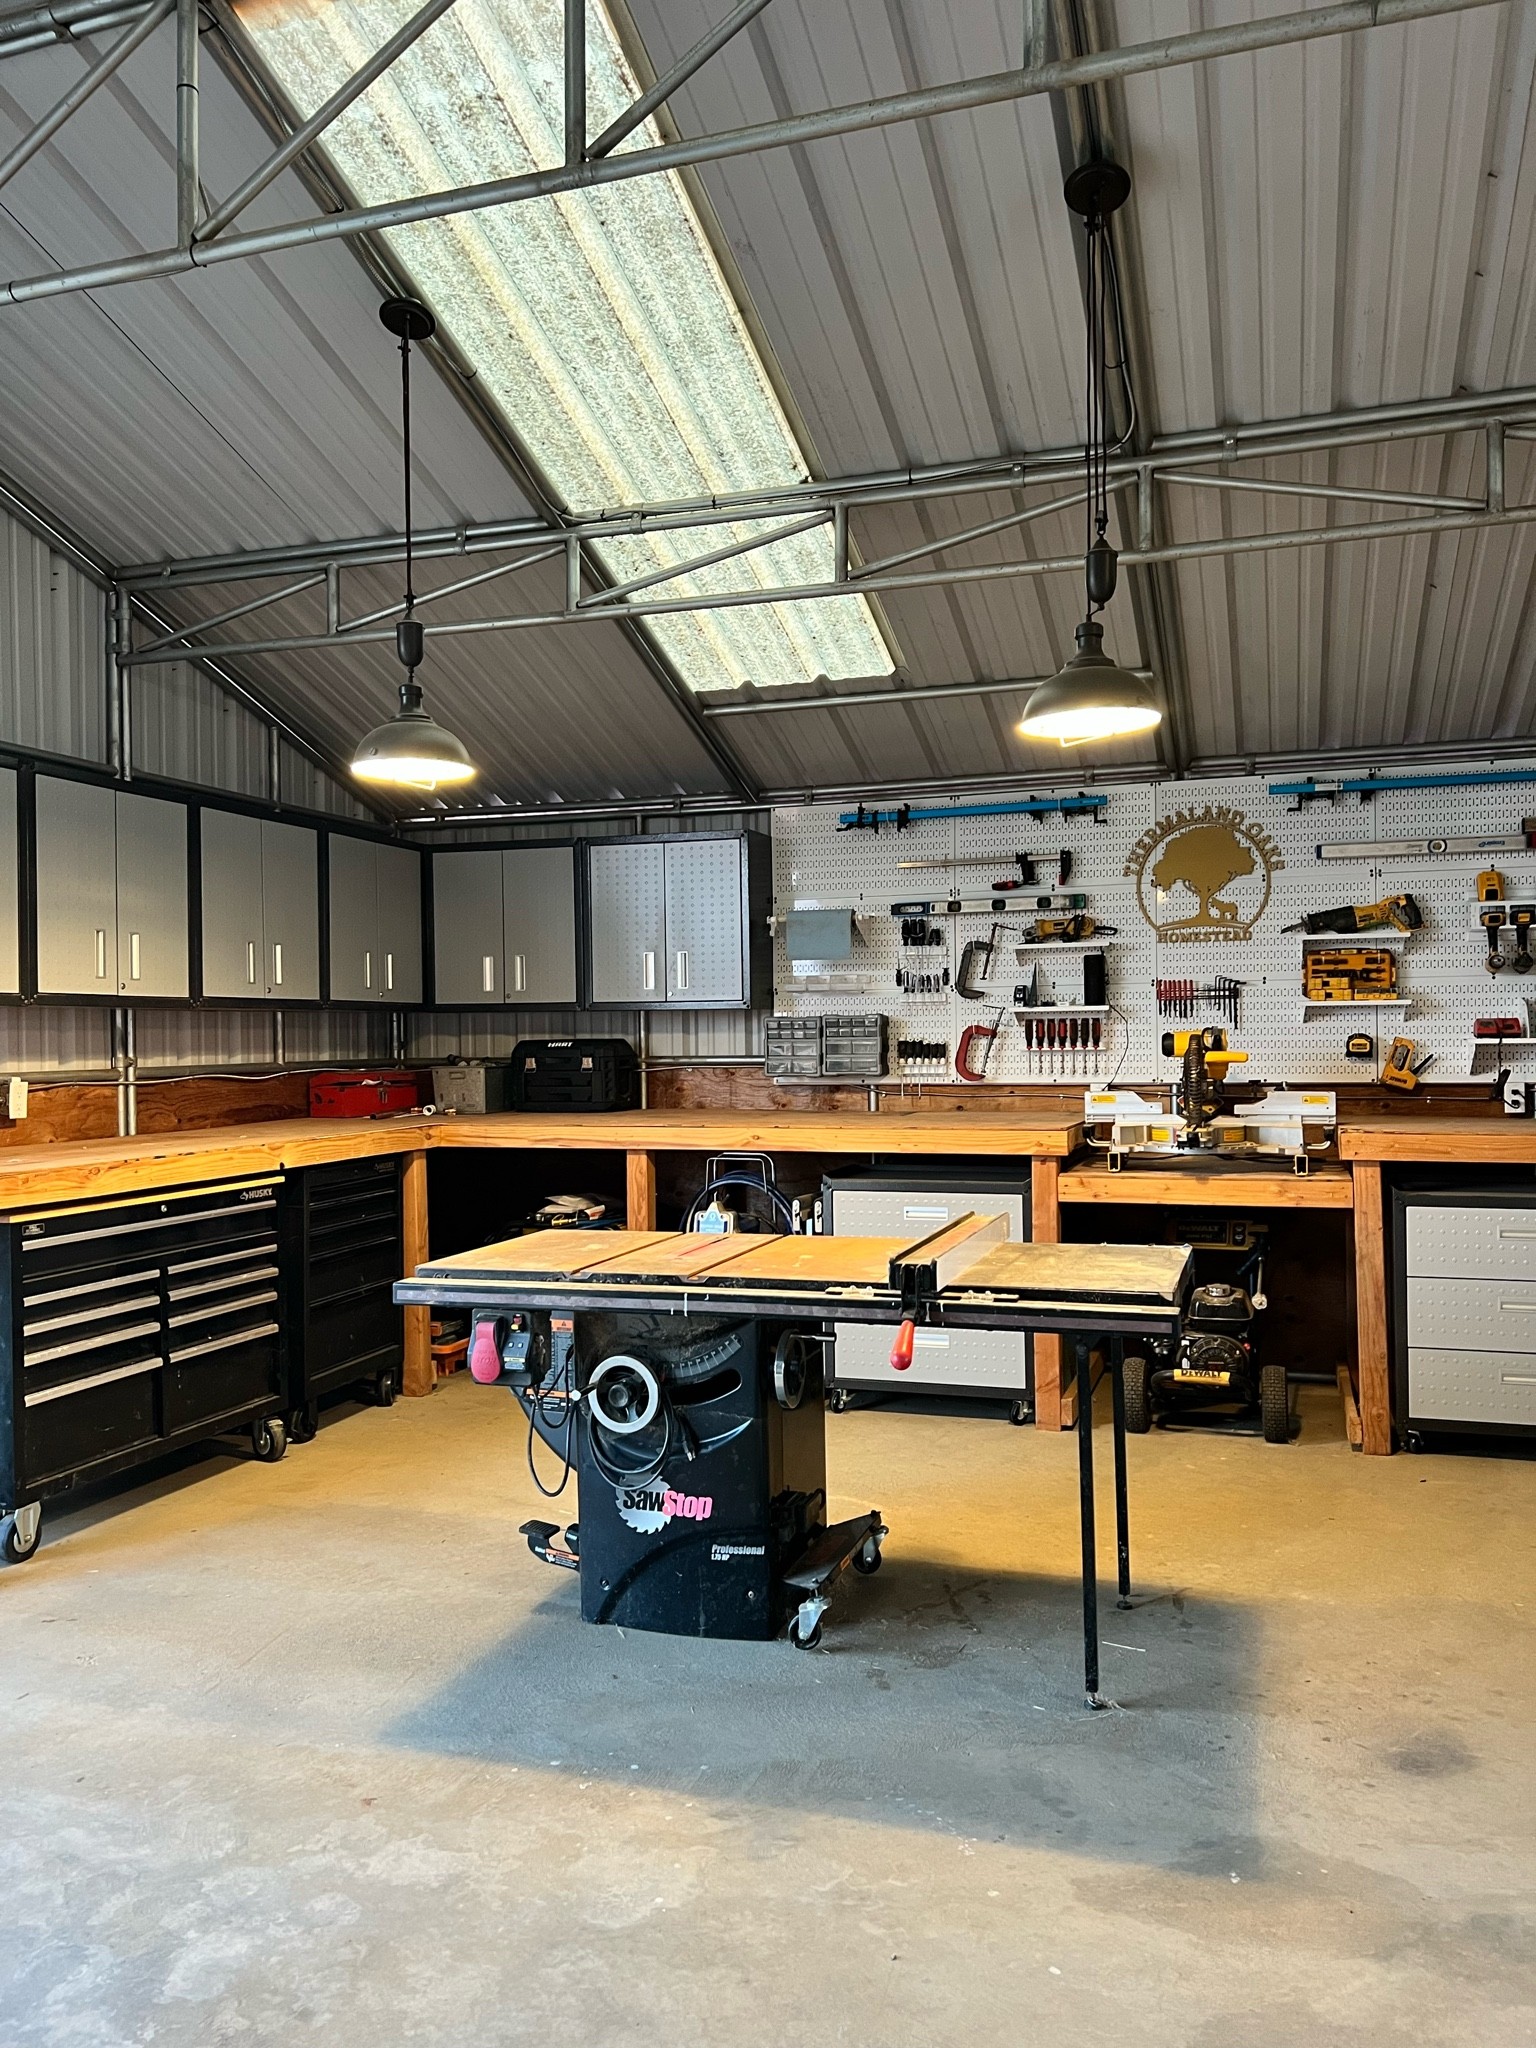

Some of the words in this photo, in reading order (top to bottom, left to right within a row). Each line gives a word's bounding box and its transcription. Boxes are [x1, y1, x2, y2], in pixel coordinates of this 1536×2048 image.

[1122, 805, 1244, 877] THERMALAND
[1247, 822, 1286, 871] OAKS
[1156, 930, 1252, 944] HOMESTEAD
[249, 1187, 273, 1199] HUSKY
[623, 1486, 713, 1521] SawStop
[711, 1544, 765, 1555] Professional
